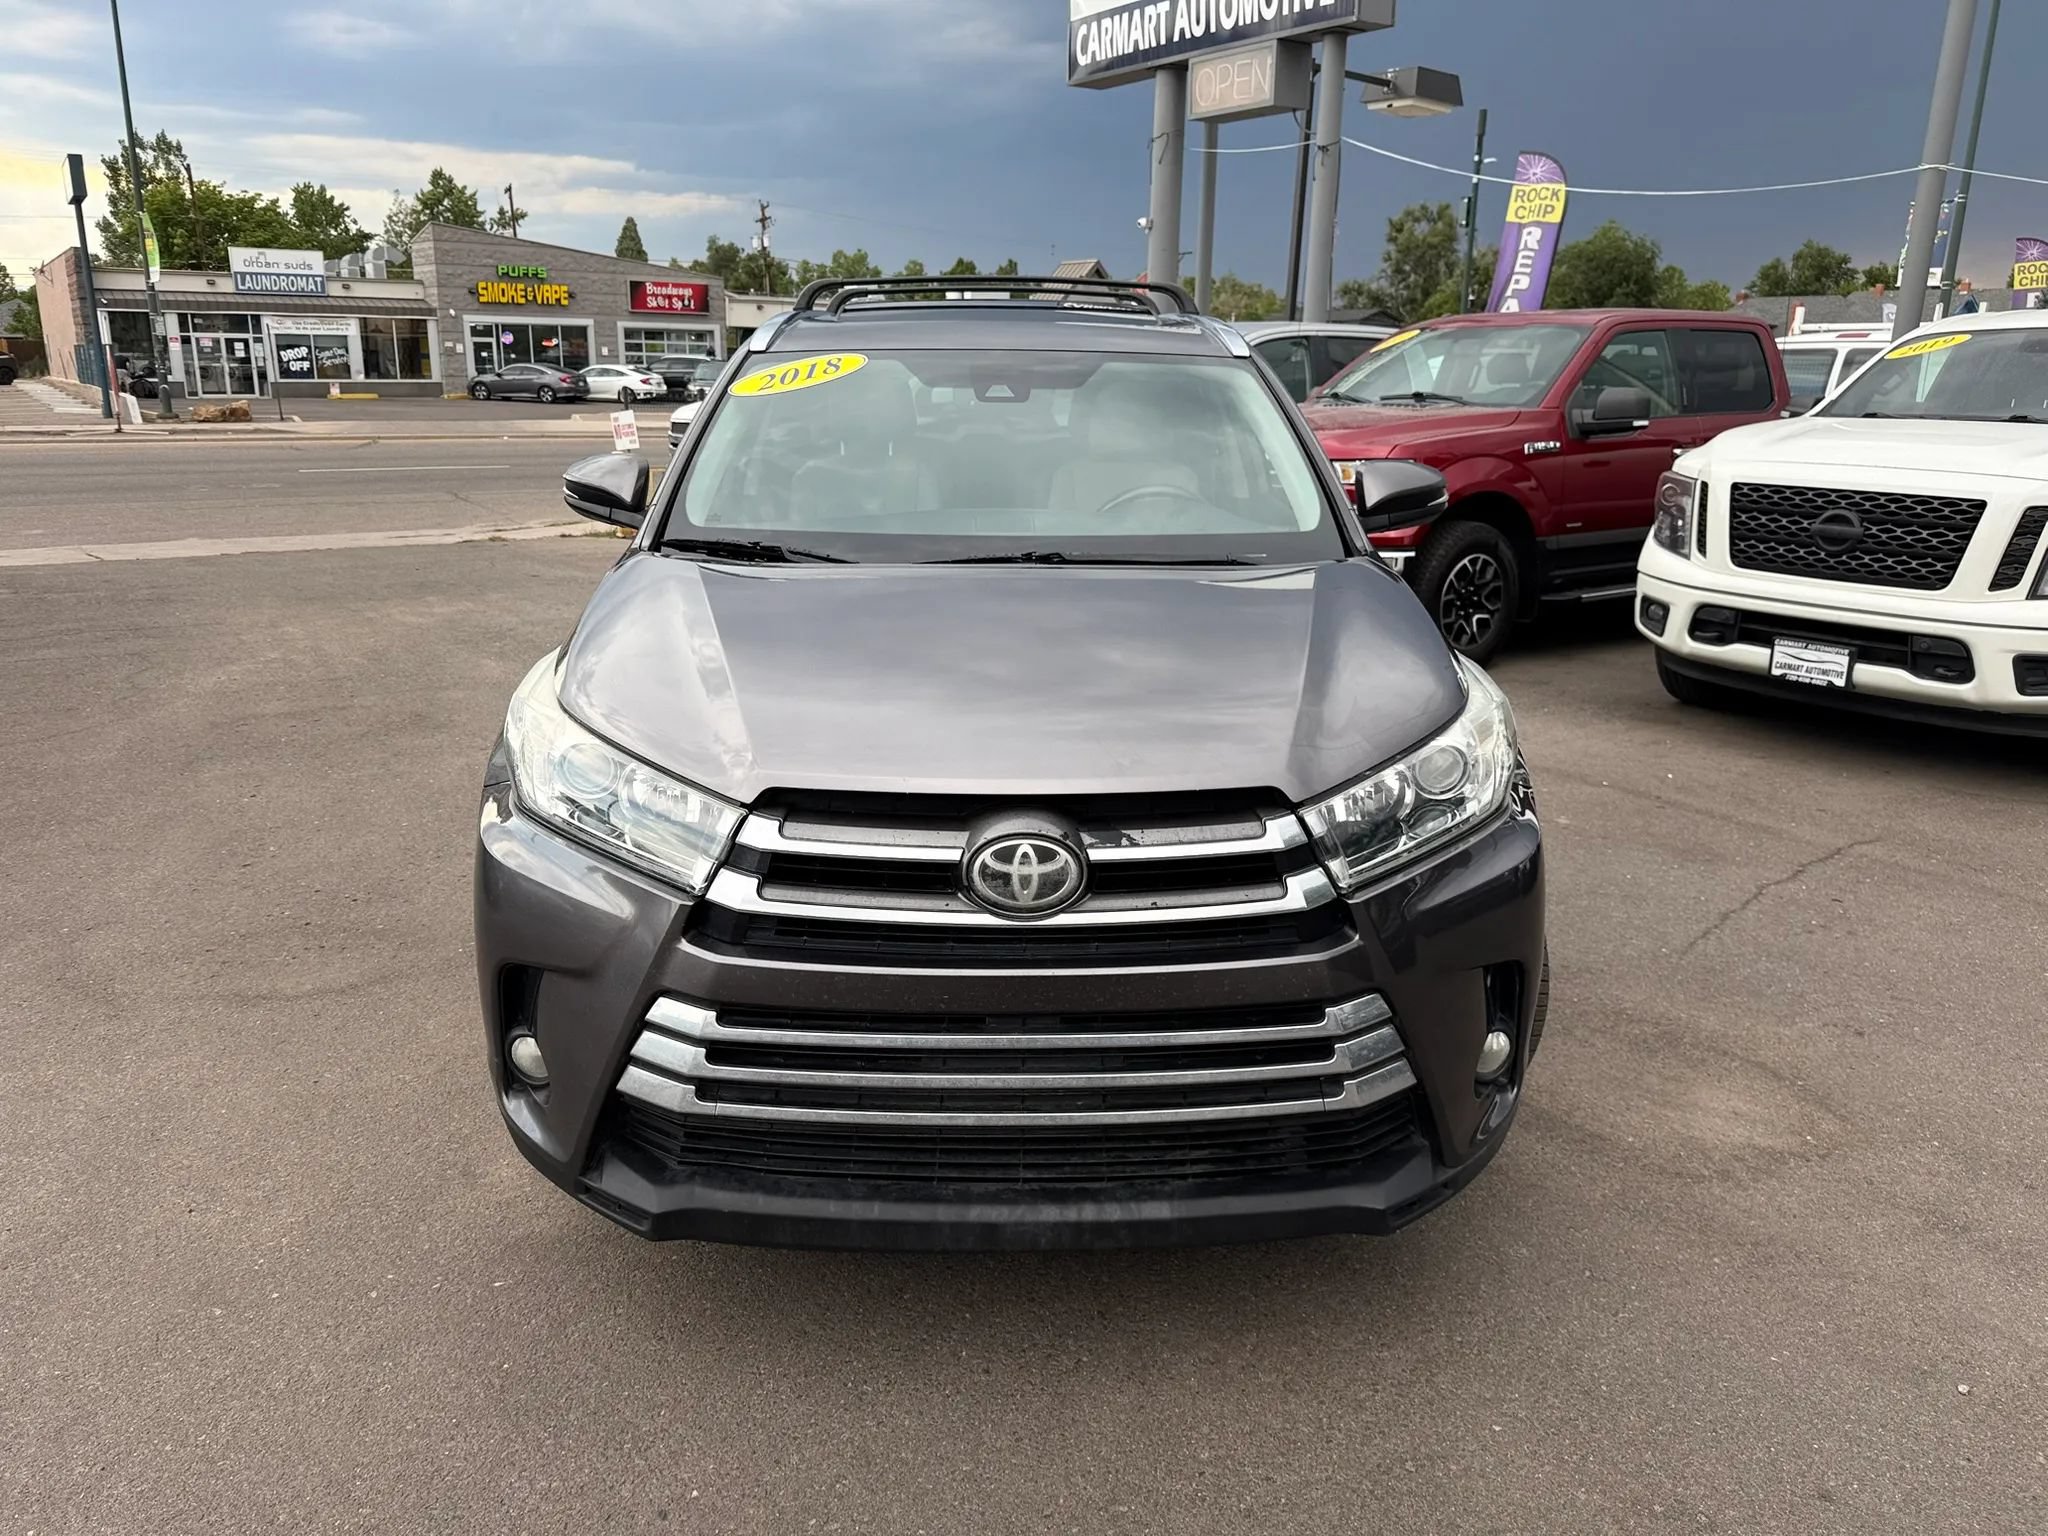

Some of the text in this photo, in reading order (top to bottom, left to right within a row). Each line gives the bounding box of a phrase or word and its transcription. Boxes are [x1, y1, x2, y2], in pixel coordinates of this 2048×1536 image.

[1076, 1, 1170, 66] CARMART
[1196, 57, 1272, 106] OPEN
[1514, 186, 1562, 203] ROCK
[1514, 203, 1555, 220] CHIP
[284, 260, 314, 271] suds
[497, 264, 547, 278] PUFFS
[236, 273, 323, 292] LAUNDROMAT
[477, 281, 526, 305] SMOKE
[534, 283, 570, 306] VAPE
[280, 346, 309, 362] DROP
[289, 360, 311, 372] OFF
[757, 357, 842, 392] 2018
[1774, 661, 1845, 680] CARMART AUTOMOTIVE
